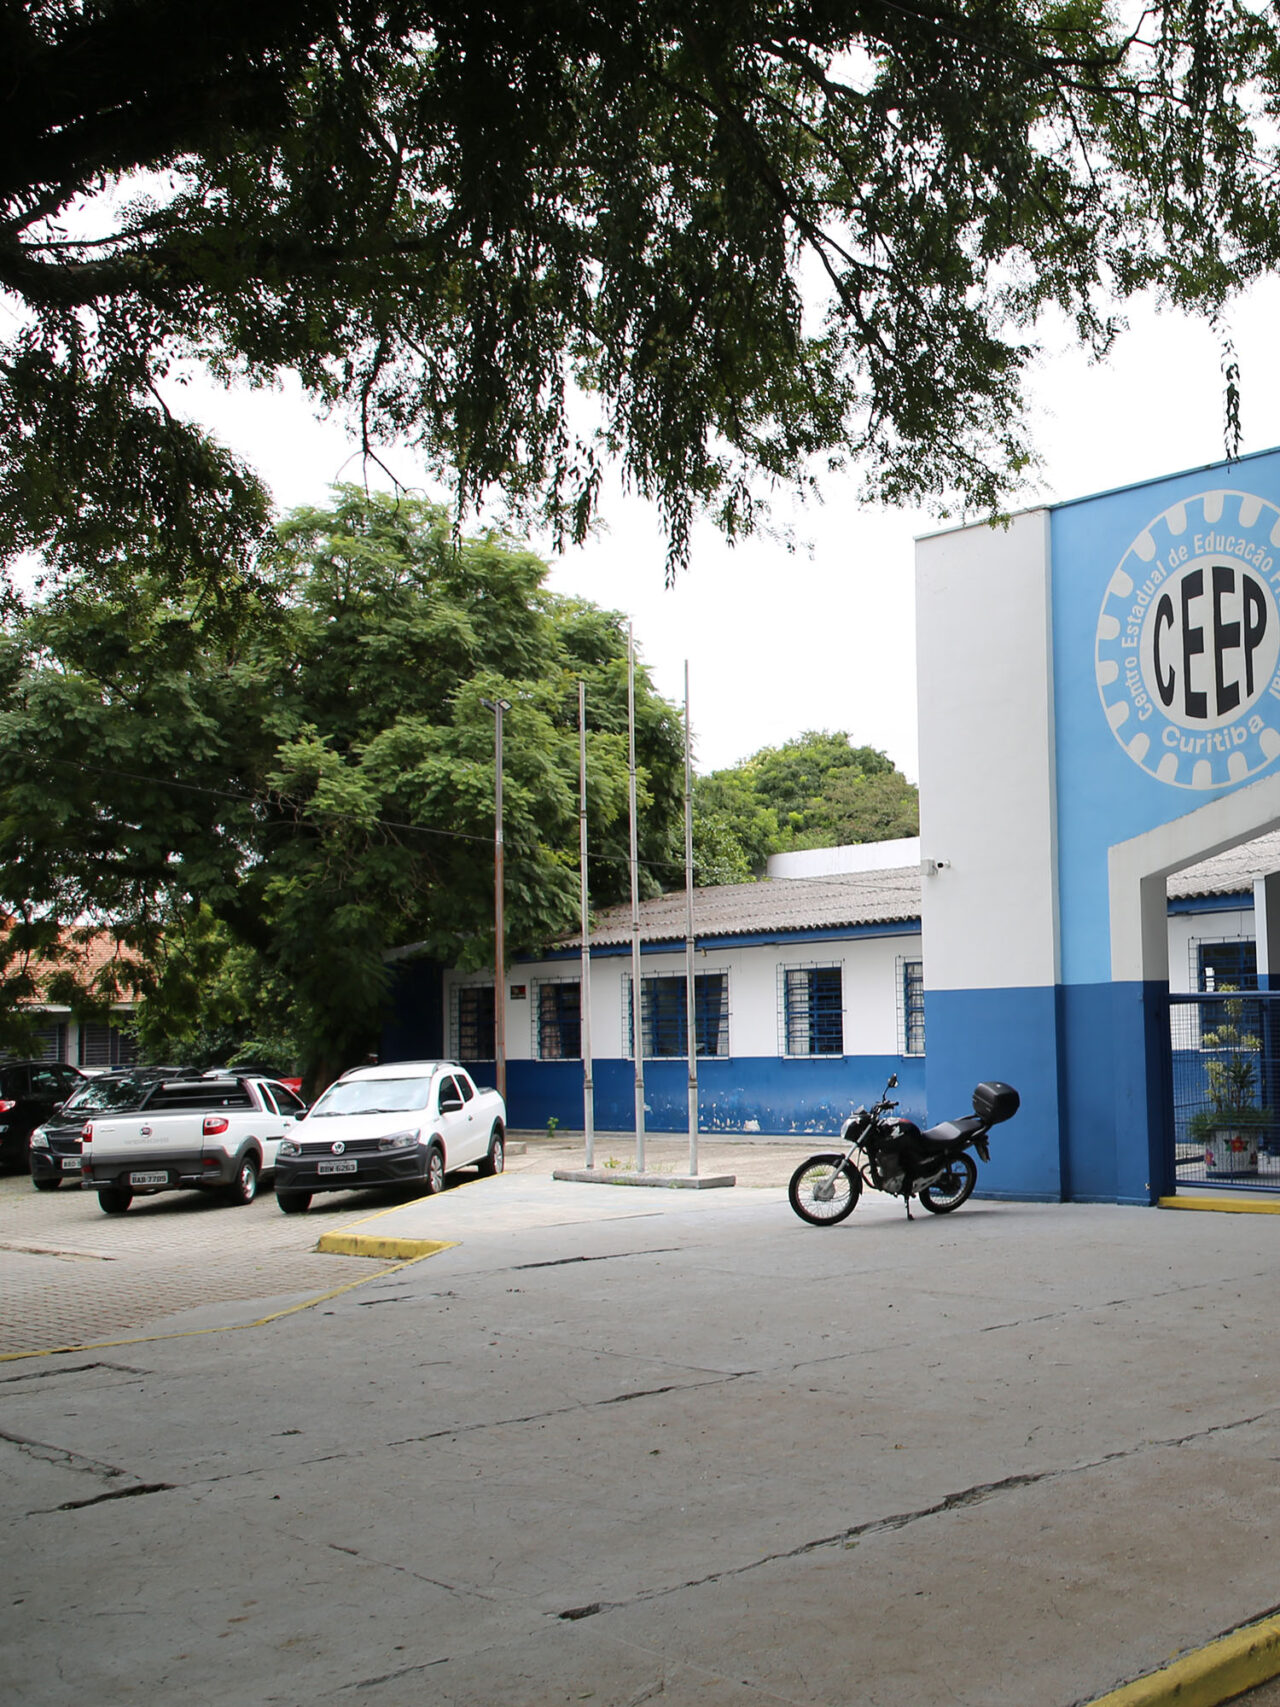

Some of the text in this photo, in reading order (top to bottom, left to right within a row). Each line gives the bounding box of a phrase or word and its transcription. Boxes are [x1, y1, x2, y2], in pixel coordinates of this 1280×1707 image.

[1121, 560, 1167, 648] Estadual
[1168, 545, 1189, 568] de
[1153, 566, 1267, 719] CEEP
[1161, 714, 1264, 753] Curitiba
